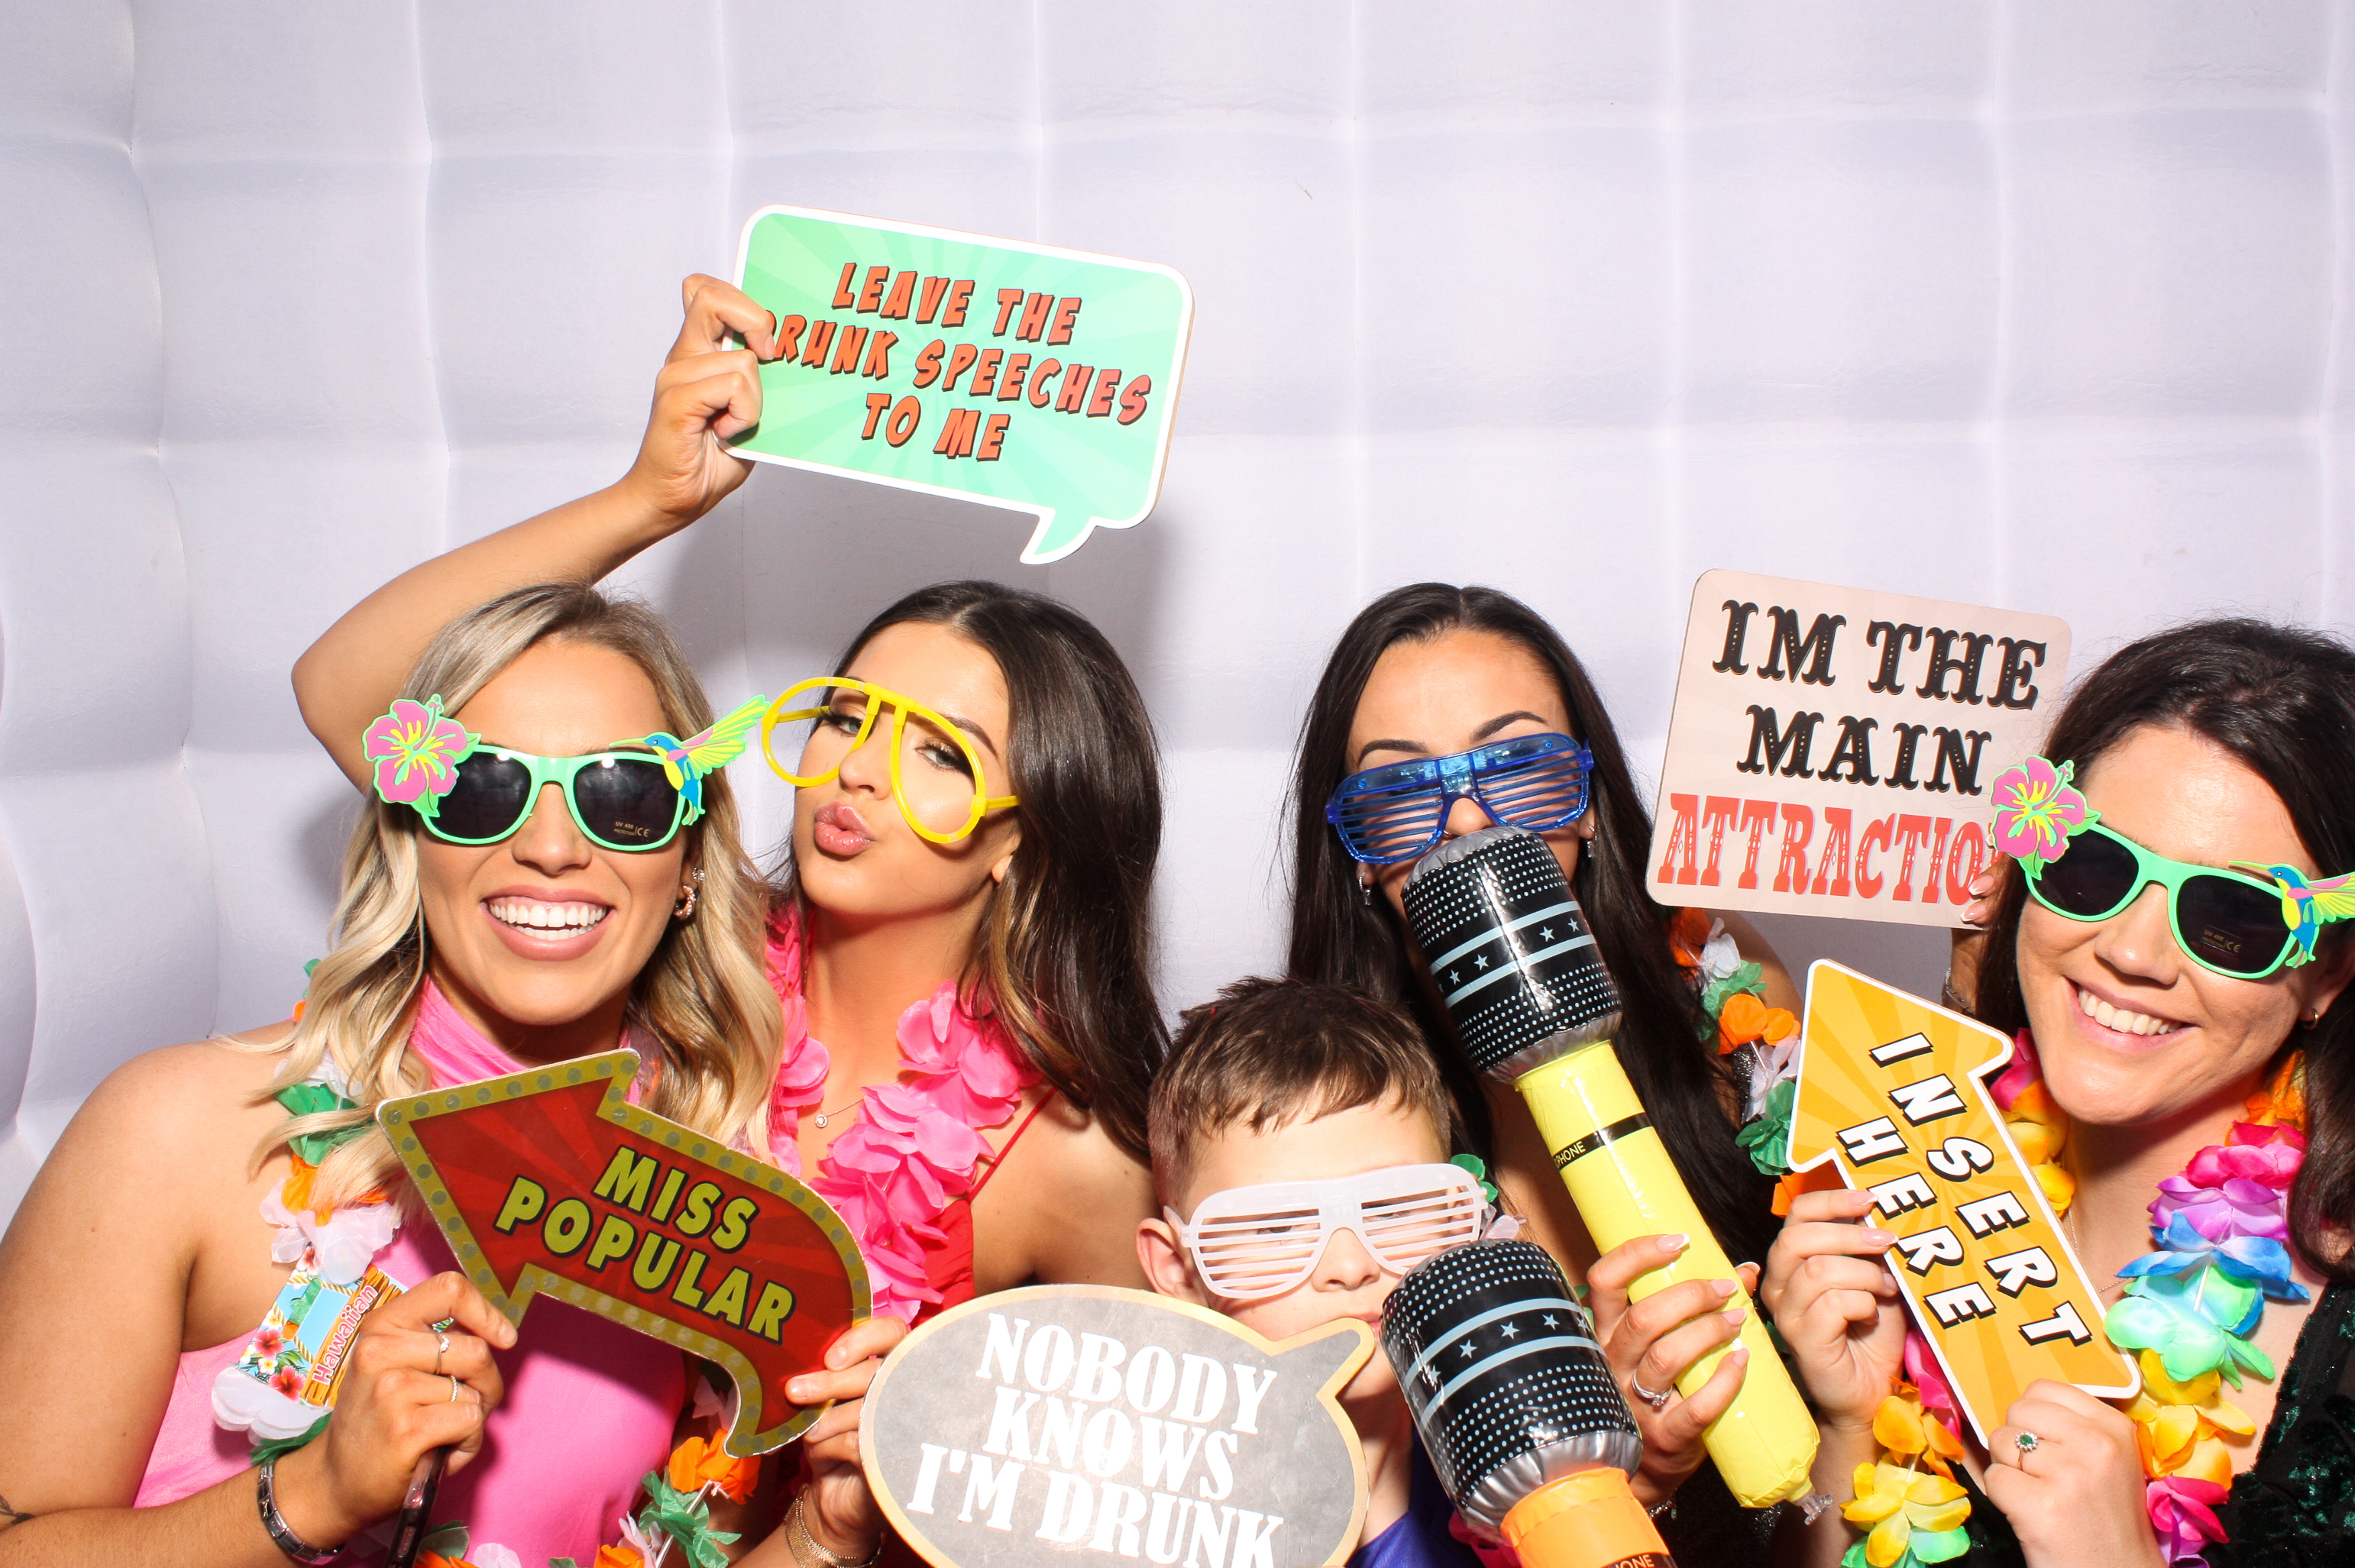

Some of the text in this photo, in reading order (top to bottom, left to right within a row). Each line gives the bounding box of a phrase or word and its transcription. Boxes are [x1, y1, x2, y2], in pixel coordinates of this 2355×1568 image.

[832, 262, 1081, 346] LEAVE THE
[746, 309, 1151, 425] RUNK SPEECHES
[861, 393, 1011, 462] TO ME
[1712, 600, 2047, 711] IM THE
[1736, 703, 1991, 796] MAIN
[1657, 792, 2005, 907] ATTRACTIO
[592, 1145, 759, 1253] MISS
[1836, 1114, 1996, 1329] HERE
[1868, 1032, 2093, 1347] INSERT
[493, 1175, 797, 1345] POPULAR
[312, 1284, 379, 1386] Hawaiian
[975, 1312, 1277, 1435] NOBODY
[982, 1385, 1238, 1502] KNOWS
[906, 1442, 1285, 1568] I'M DRUNK
